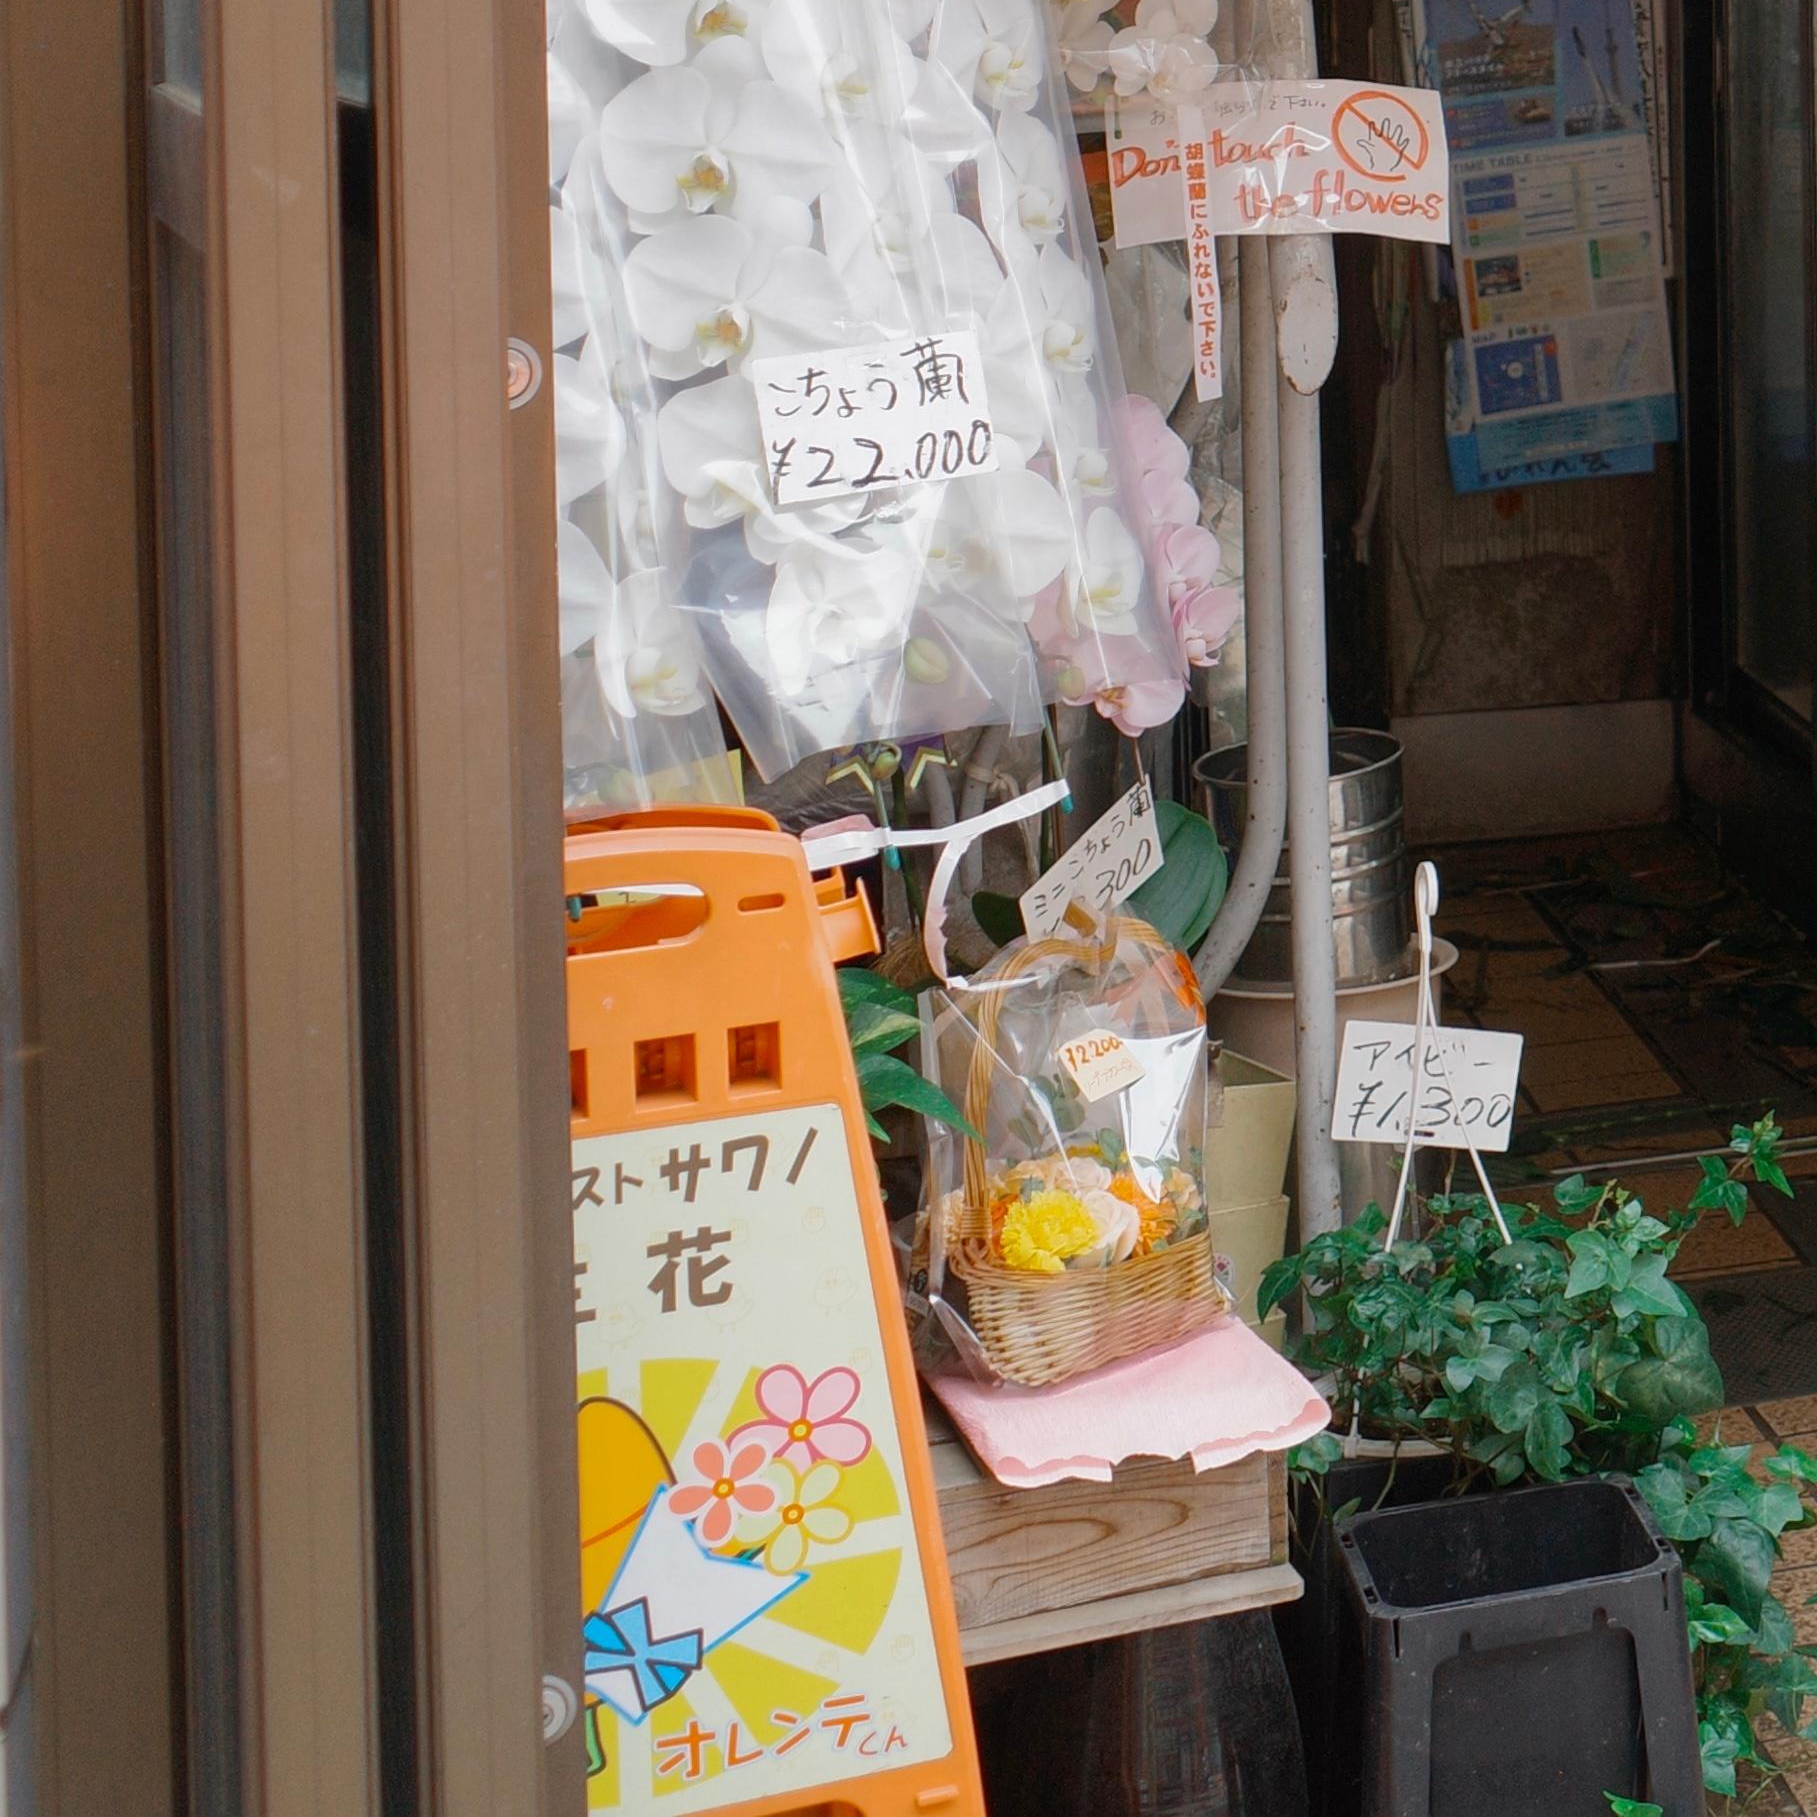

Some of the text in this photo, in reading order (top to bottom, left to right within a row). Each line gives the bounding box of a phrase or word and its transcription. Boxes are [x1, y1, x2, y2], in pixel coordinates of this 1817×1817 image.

[1208, 121, 1311, 168] touch
[1452, 153, 1533, 174] TIME TABLE
[1234, 168, 1444, 223] the flowers
[768, 336, 970, 418] こちょう蘭
[1354, 1040, 1491, 1077] アイビー
